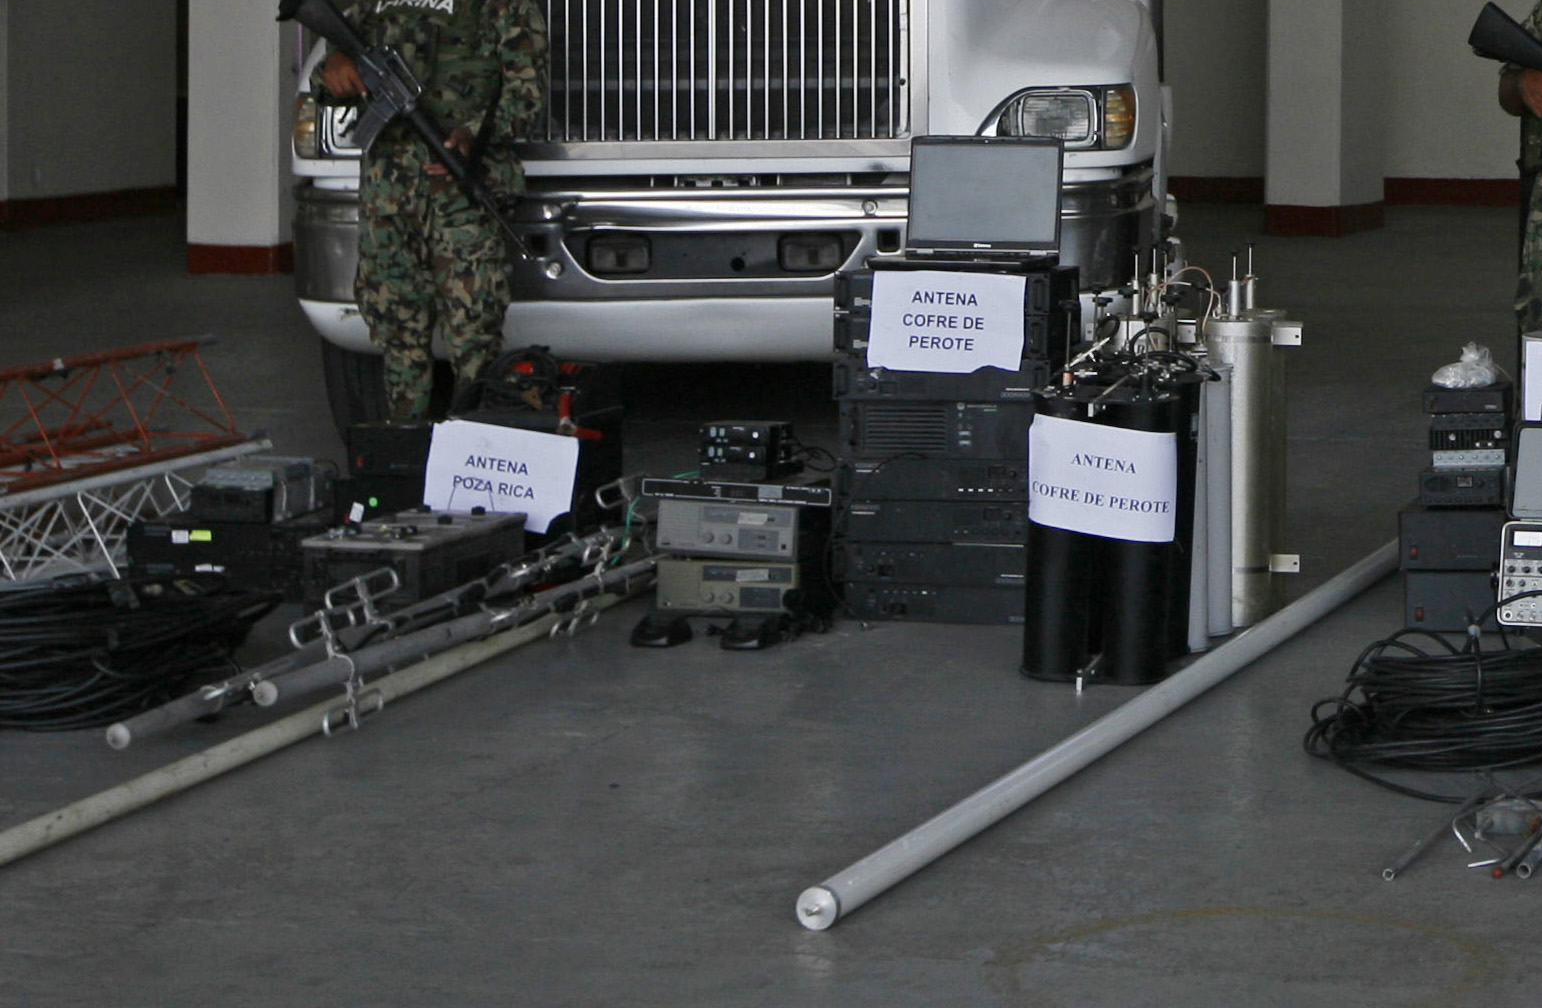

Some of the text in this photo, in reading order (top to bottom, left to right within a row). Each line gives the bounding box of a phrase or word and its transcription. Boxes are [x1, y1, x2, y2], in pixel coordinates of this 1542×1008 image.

[912, 291, 978, 306] ANTENA
[903, 313, 984, 330] COFRE DE
[909, 335, 975, 351] PEROTE
[465, 455, 528, 475] ANTENA
[1071, 453, 1137, 474] ANTENA
[453, 475, 534, 499] POZA RICA
[1032, 480, 1170, 514] COFRE DE PEROTE
